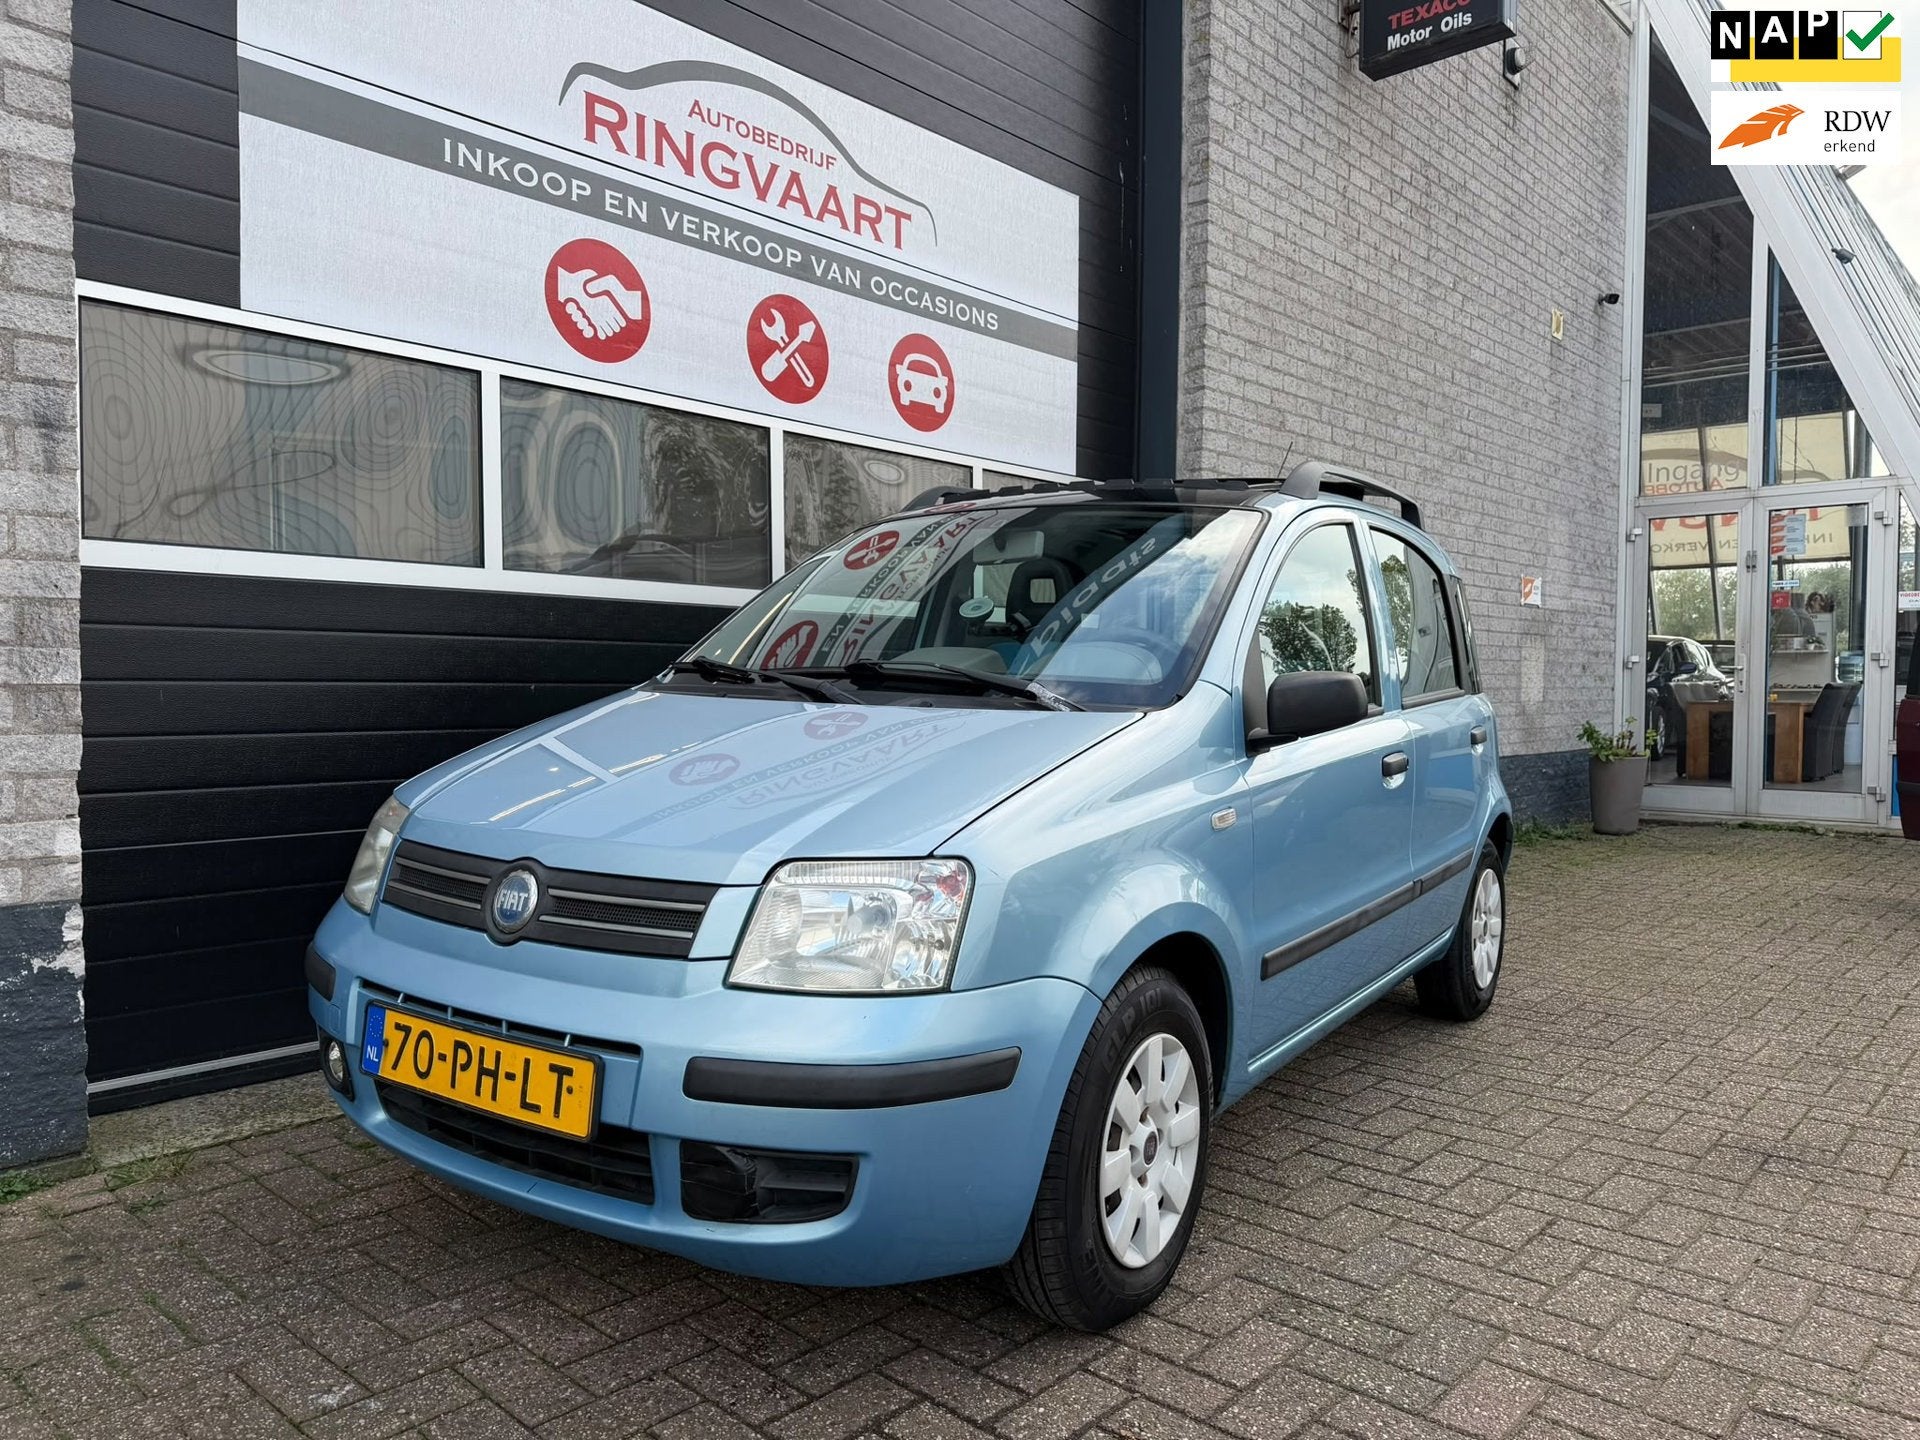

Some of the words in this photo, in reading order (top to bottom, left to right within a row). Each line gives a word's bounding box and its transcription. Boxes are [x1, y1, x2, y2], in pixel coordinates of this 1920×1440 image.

[1387, 26, 1433, 51] Motor
[1440, 12, 1472, 33] Oils
[583, 91, 912, 250] RINGVAART
[687, 98, 837, 171] AUTOBEDRIJF
[443, 137, 592, 202] INKOOP
[604, 188, 648, 223] EN
[660, 206, 802, 268] VERKOOP
[810, 255, 862, 289] VAN
[870, 276, 999, 330] OCCASIONS
[496, 889, 529, 912] FIAT
[366, 1045, 379, 1063] NL
[391, 1021, 575, 1119] 70-PH-LT
